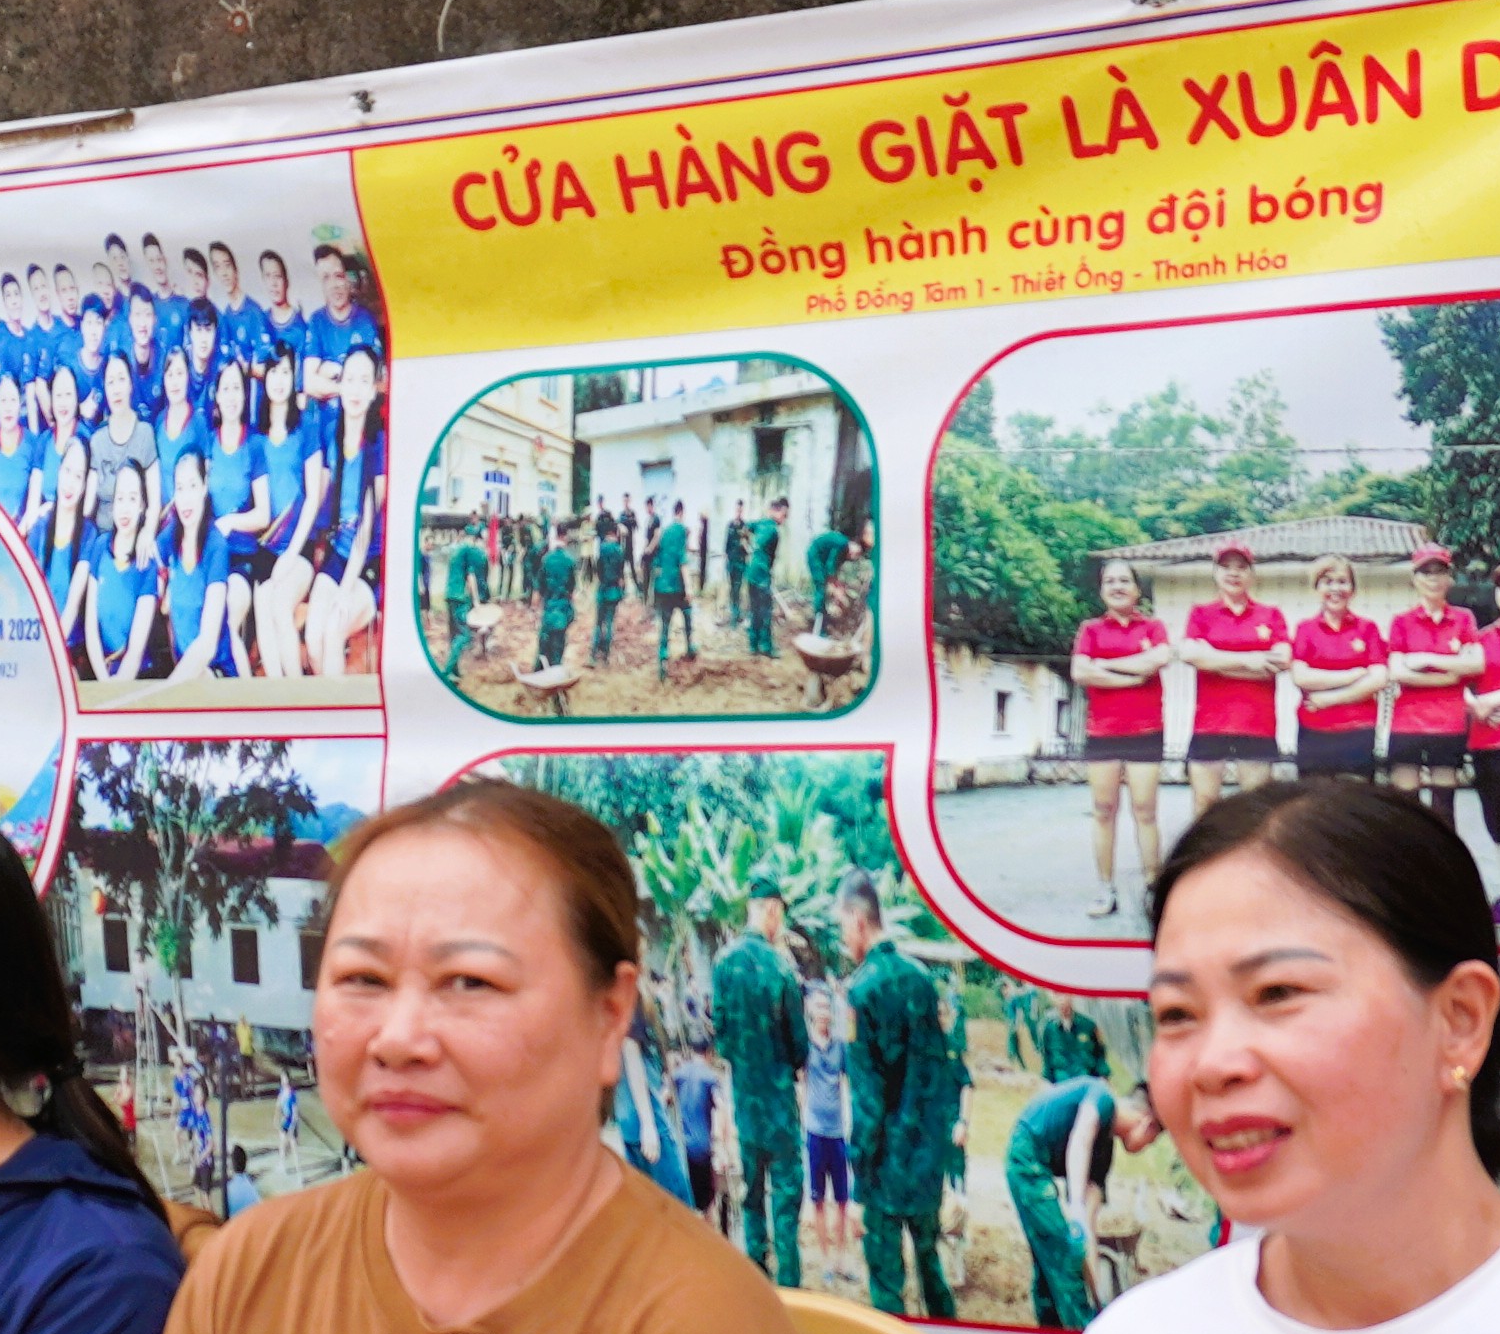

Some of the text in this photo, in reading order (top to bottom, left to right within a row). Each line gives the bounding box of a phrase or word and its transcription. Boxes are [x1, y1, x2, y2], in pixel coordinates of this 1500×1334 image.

[453, 144, 596, 230] CỬA
[615, 124, 830, 214] HÀNG
[859, 92, 1028, 192] GIẶT
[1062, 64, 1159, 159] LÀ
[1183, 39, 1422, 146] XUÂN
[720, 176, 1384, 280] Đồng hành cùng đội bóng
[807, 288, 846, 315] Phố
[856, 281, 913, 312] Đồng
[925, 281, 969, 303] Tâm
[977, 280, 985, 300] 1
[1153, 255, 1227, 283] Thanh
[1238, 249, 1288, 273] Hóa
[9, 618, 40, 641] 2023
